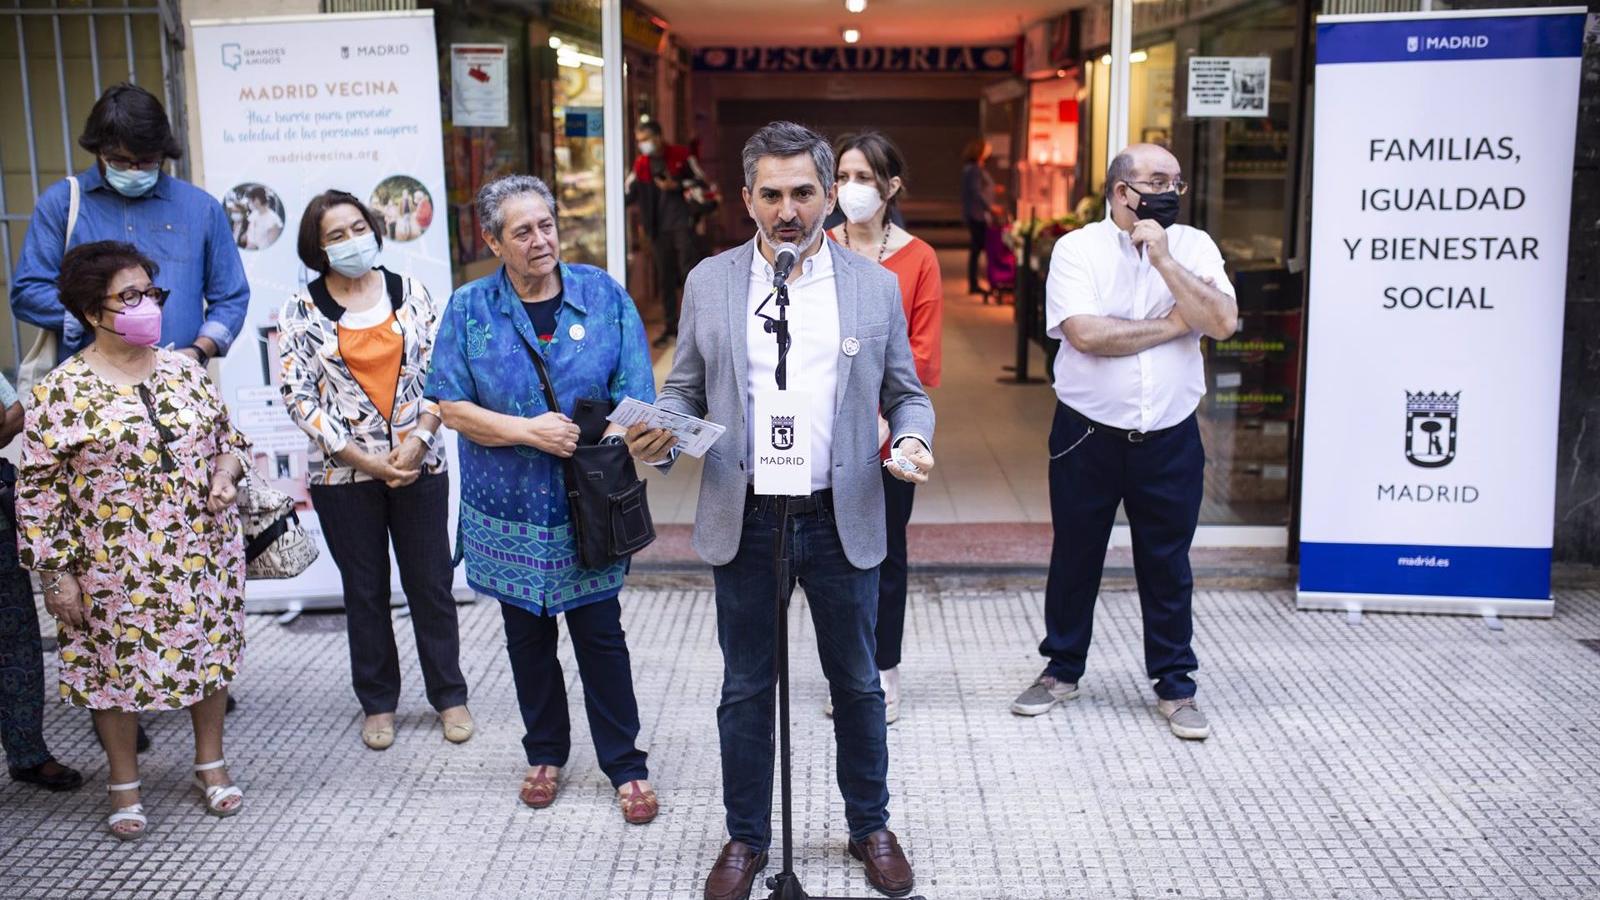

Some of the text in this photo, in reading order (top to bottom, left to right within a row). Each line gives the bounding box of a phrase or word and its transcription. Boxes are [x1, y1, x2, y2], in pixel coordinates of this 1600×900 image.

[357, 45, 409, 56] MADRID
[1426, 36, 1488, 49] MADRID
[239, 81, 399, 101] MADRID VECINA
[246, 110, 271, 125] Haz
[314, 110, 342, 125] para
[223, 129, 235, 143] la
[238, 127, 280, 143] soledad
[283, 126, 297, 141] de
[301, 126, 317, 140] las
[321, 127, 370, 142] personas
[268, 149, 379, 163] madridvecina.org
[1370, 136, 1521, 164] FAMILIAS,
[1361, 187, 1526, 212] IGUALDAD
[1343, 237, 1539, 261] Y BIENESTAR
[1383, 286, 1495, 310] SOCIAL
[760, 456, 805, 466] MADRID
[1377, 484, 1480, 504] MADRID
[1398, 555, 1450, 568] madrid.es
